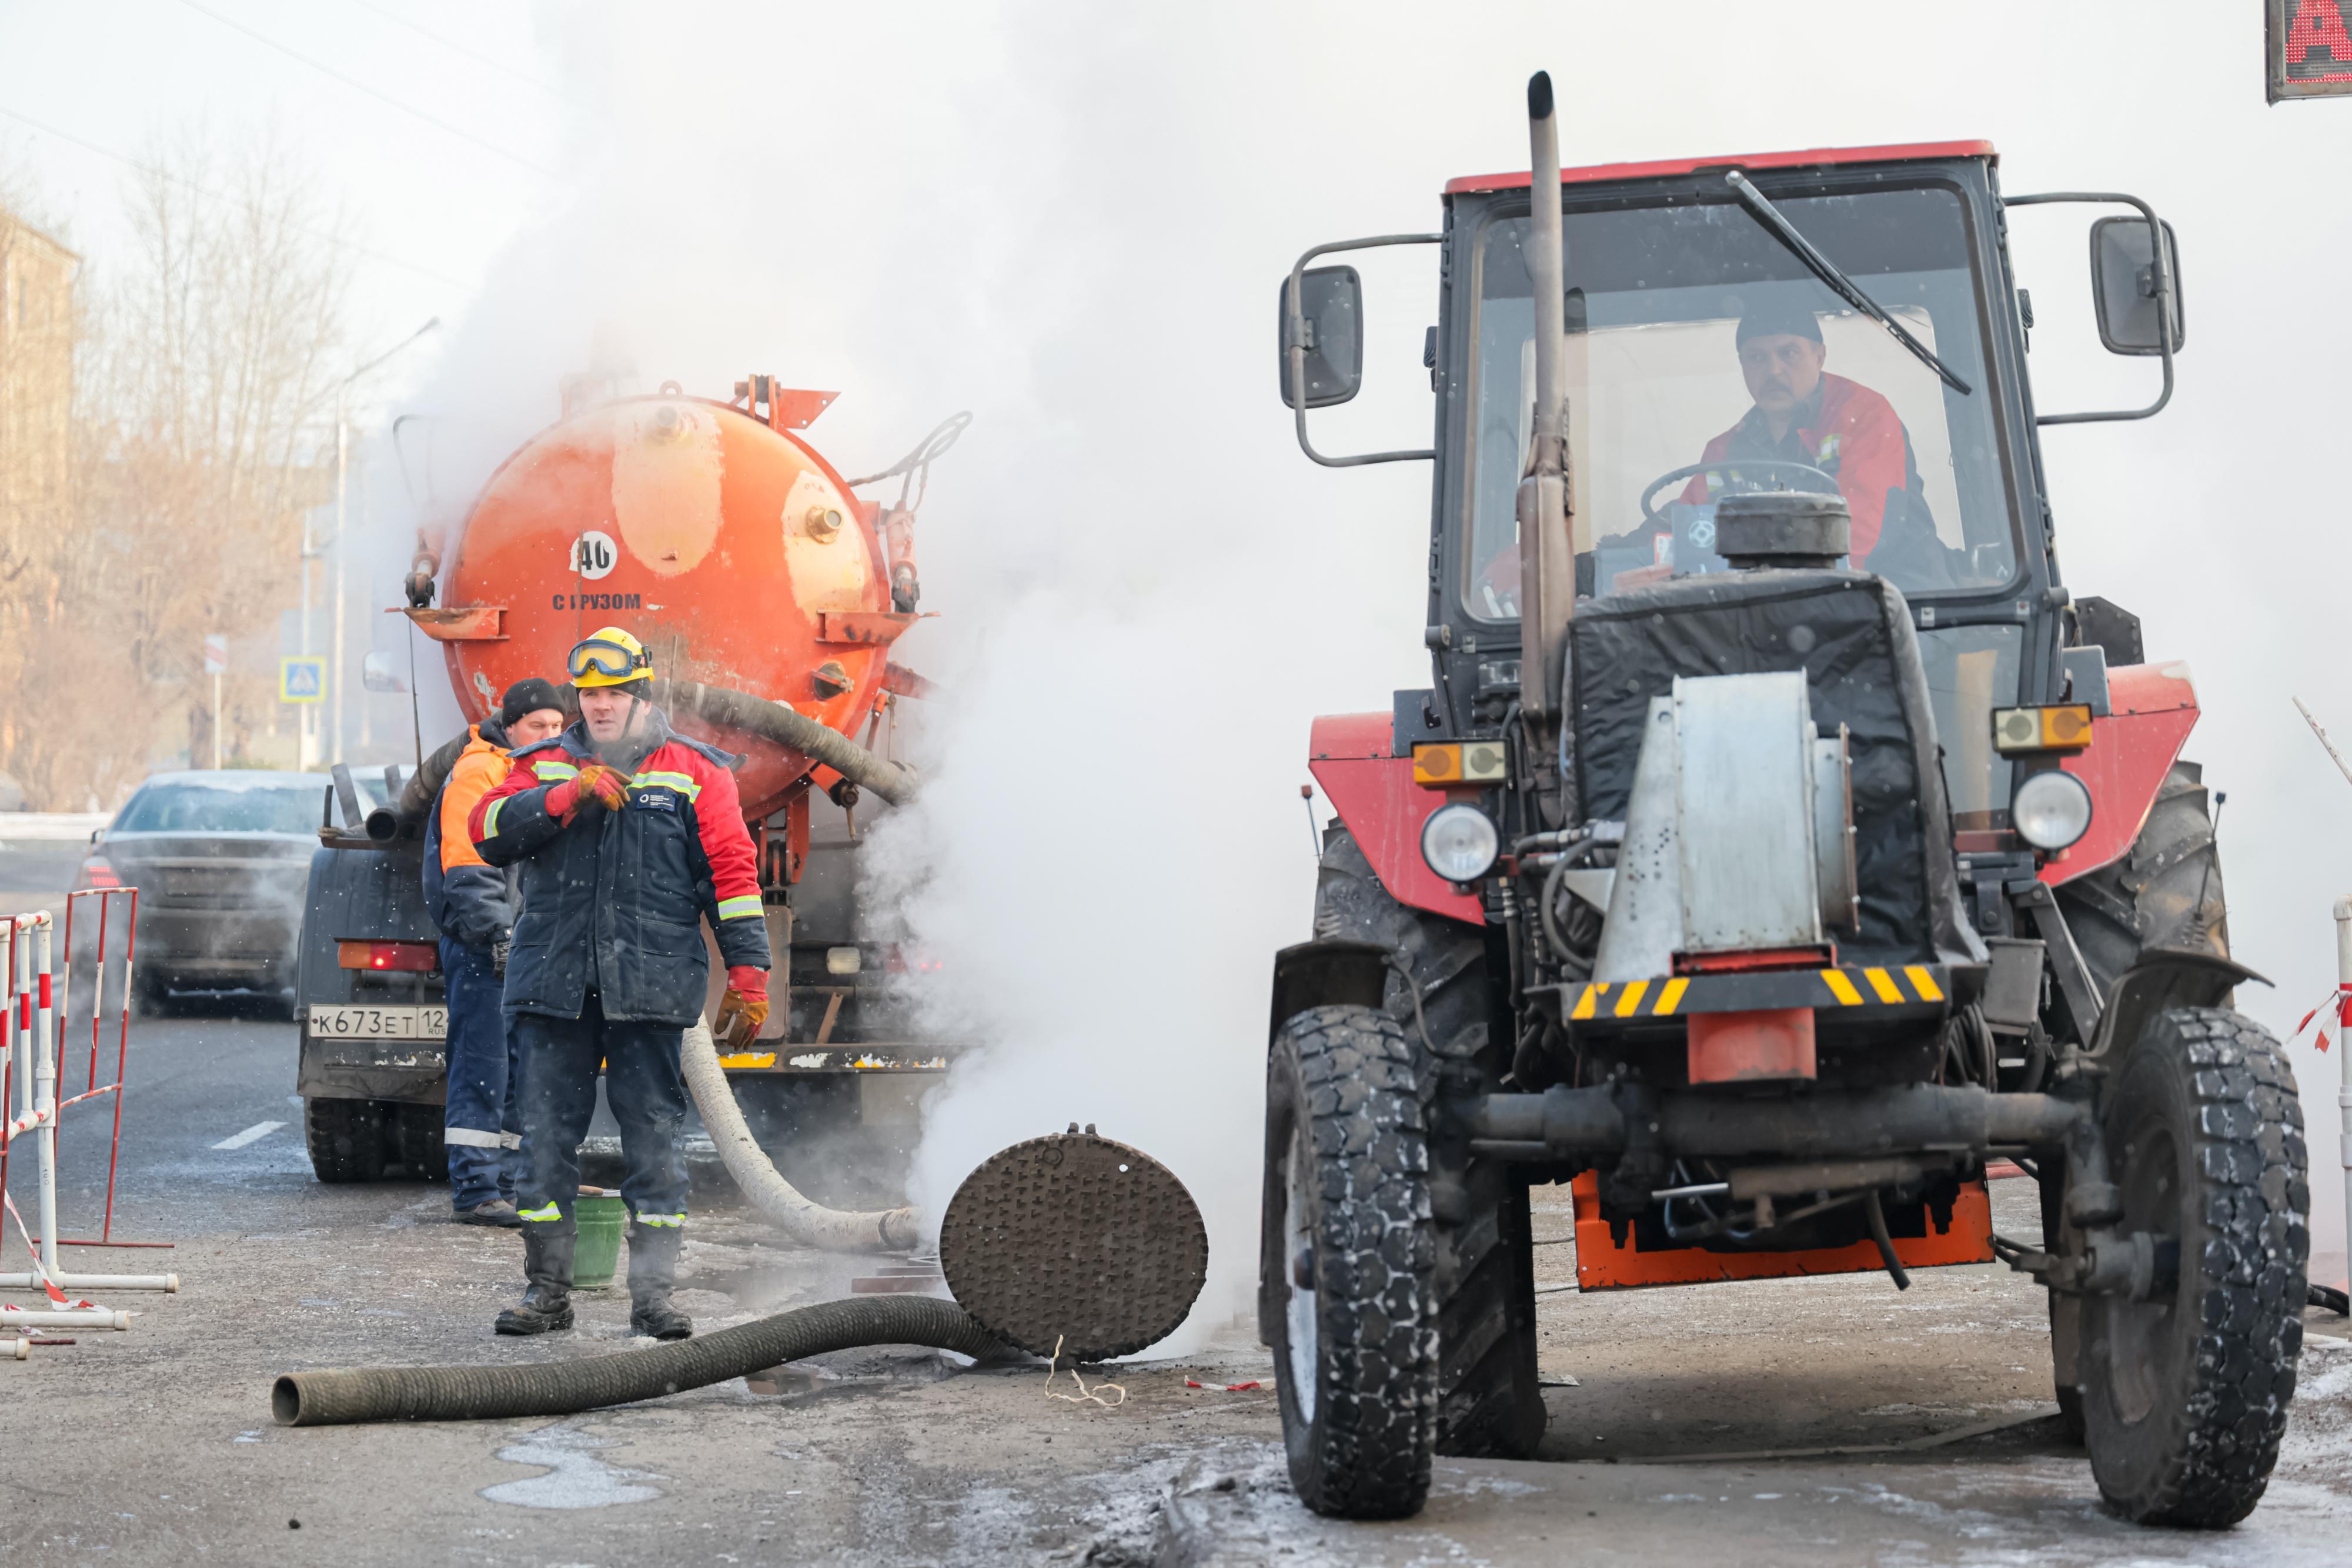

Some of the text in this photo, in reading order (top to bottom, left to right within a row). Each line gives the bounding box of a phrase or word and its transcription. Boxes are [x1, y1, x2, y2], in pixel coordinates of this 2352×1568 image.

[579, 540, 610, 571] 40
[553, 594, 565, 610] С
[319, 1010, 449, 1034] К673ЕТ 12
